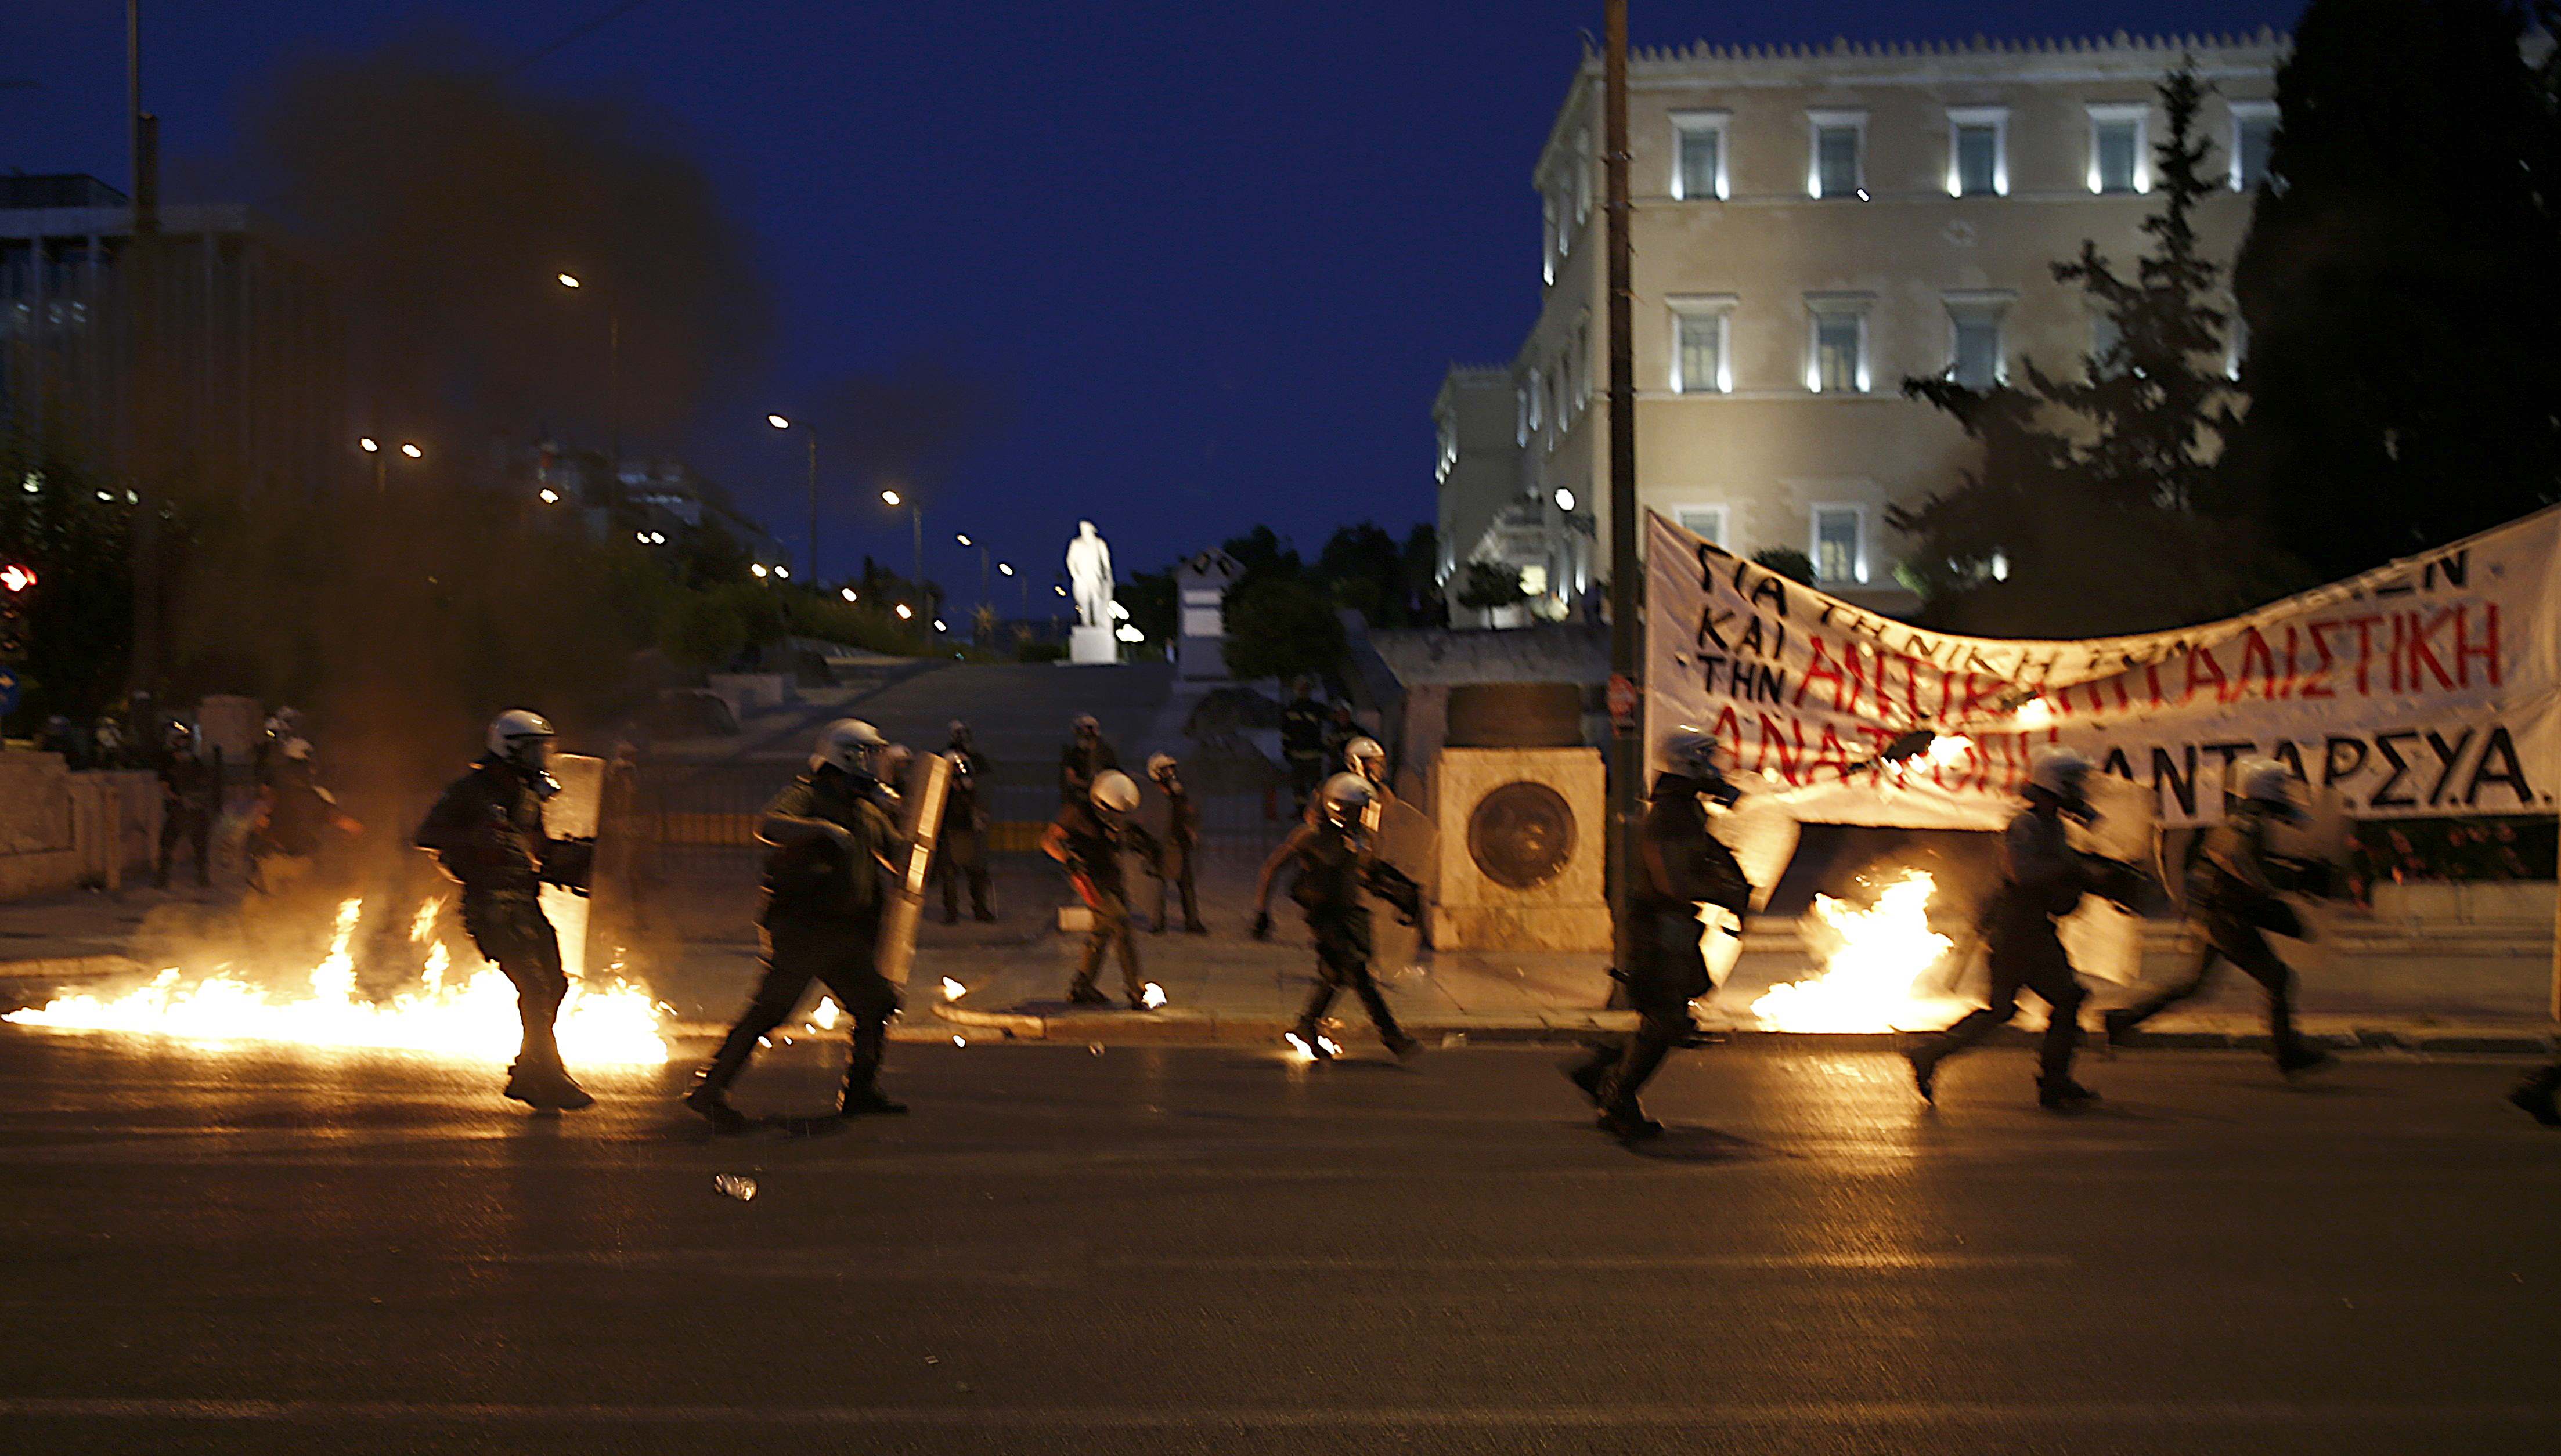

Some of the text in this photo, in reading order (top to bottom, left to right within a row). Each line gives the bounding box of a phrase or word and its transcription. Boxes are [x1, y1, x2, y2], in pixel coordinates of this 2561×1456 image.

[1697, 543, 1789, 617] ΓΙΑ
[1697, 606, 1785, 660] ΚΑΙ
[1696, 655, 1787, 704] ΤΗΝ
